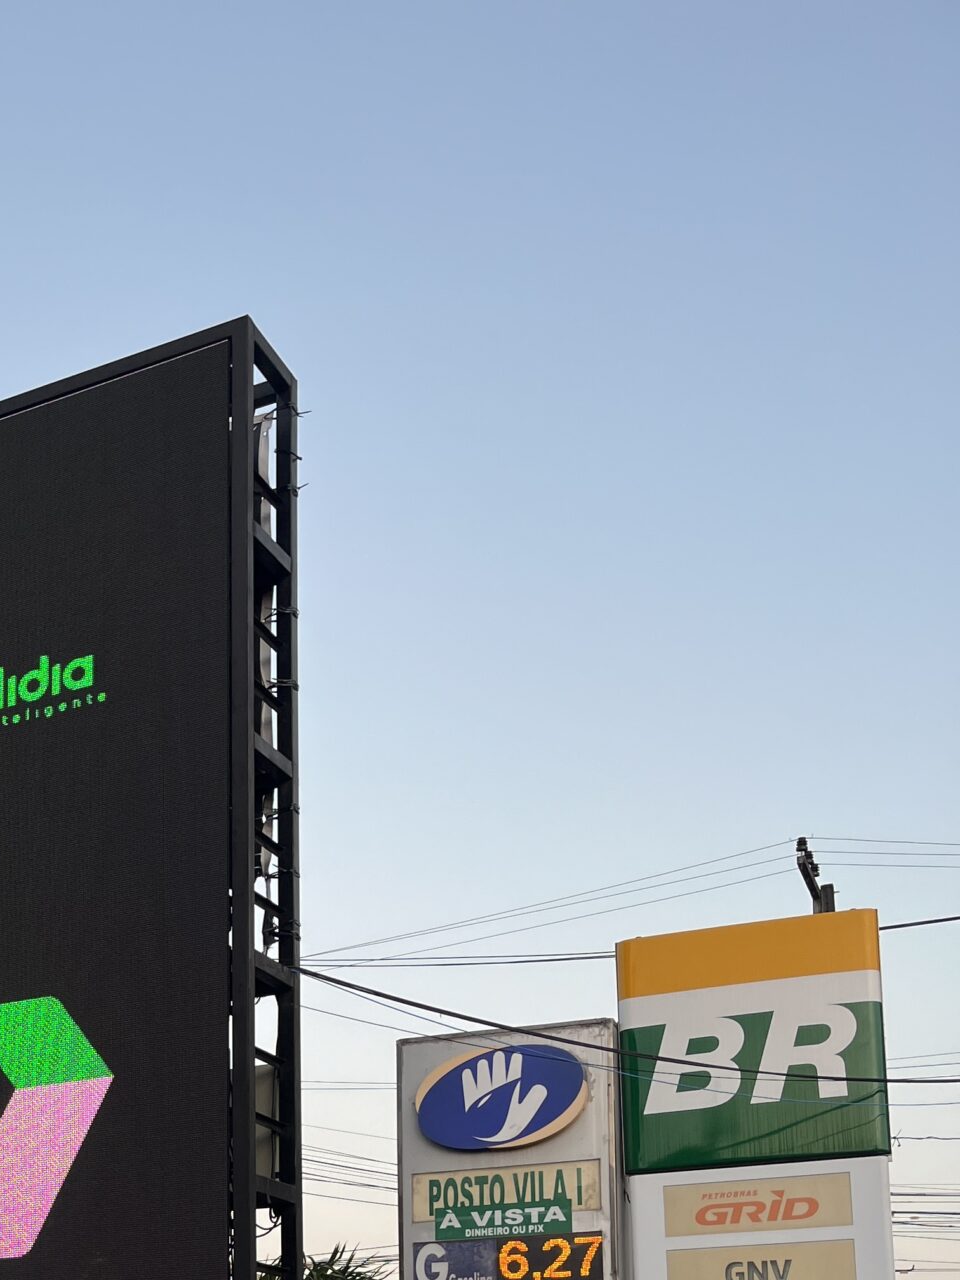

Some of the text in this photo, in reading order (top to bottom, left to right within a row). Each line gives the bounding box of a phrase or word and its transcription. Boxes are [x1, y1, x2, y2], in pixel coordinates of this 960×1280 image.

[644, 1004, 857, 1115] BR
[429, 1174, 505, 1217] POSTO
[513, 1169, 568, 1203] VILA
[702, 1190, 759, 1200] PETROBRAS
[440, 1206, 566, 1229] À VISTA
[695, 1190, 819, 1226] GRID
[465, 1224, 544, 1237] DINHEIRO OU PIX
